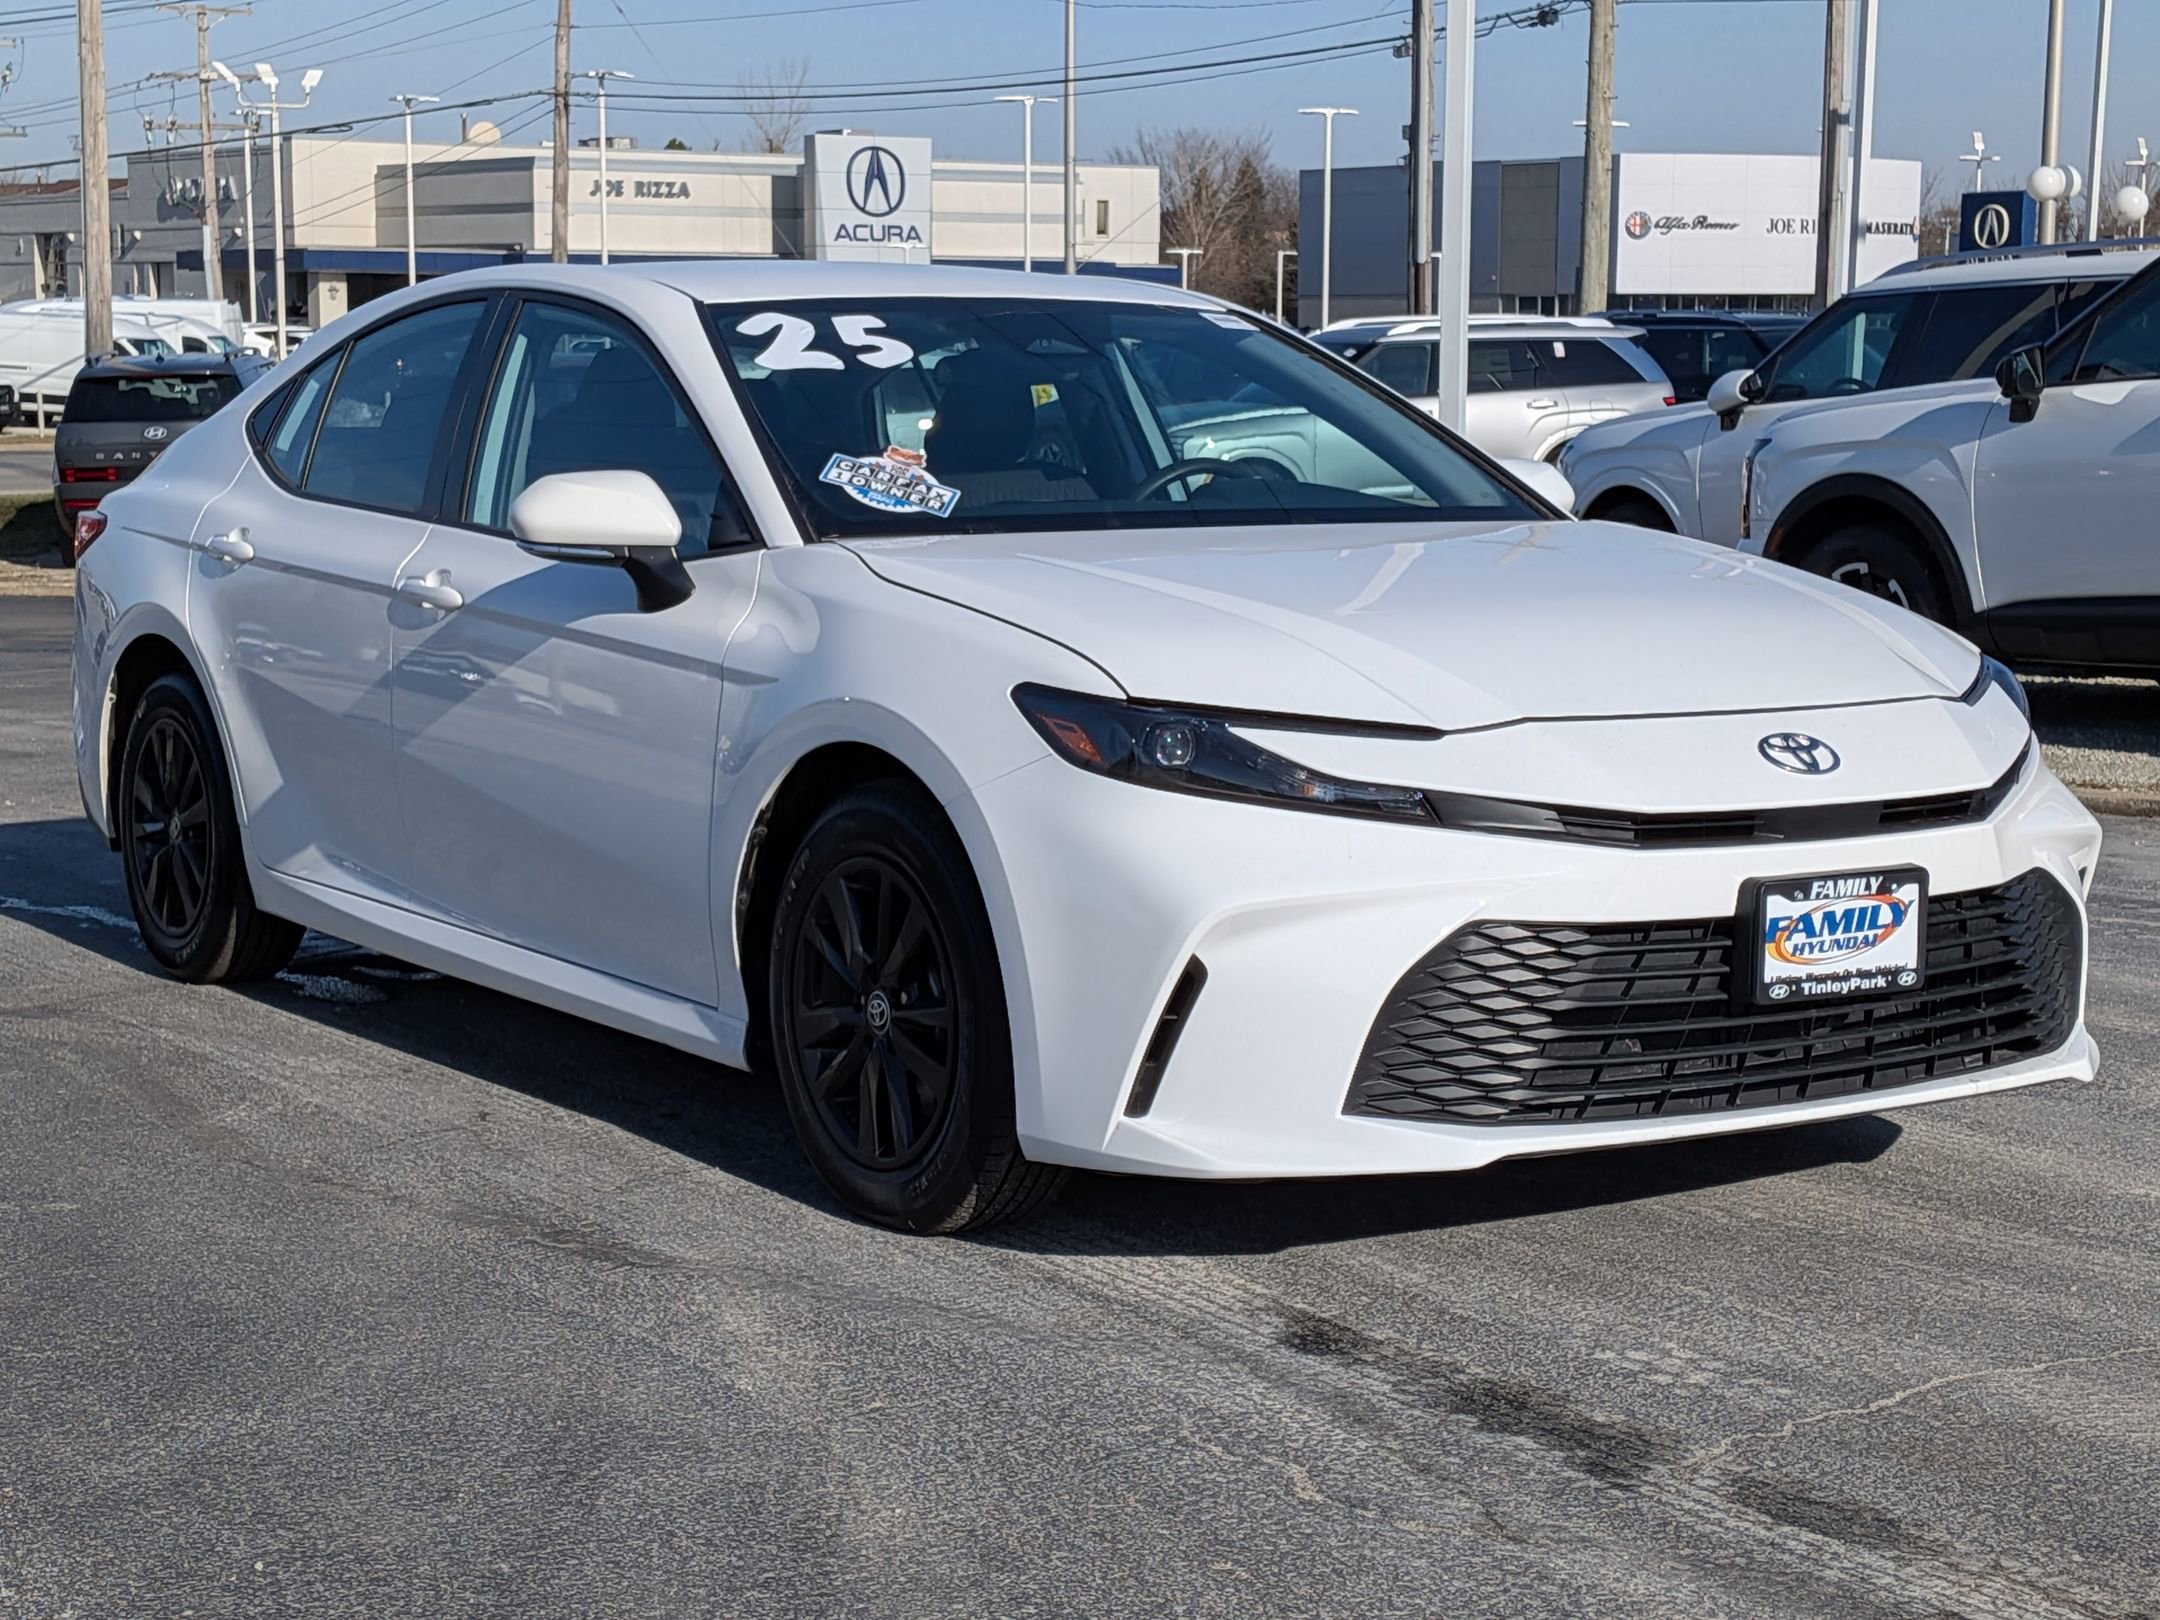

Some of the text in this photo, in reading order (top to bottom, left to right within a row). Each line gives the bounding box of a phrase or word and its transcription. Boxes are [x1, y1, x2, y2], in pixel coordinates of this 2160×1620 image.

[589, 179, 692, 200] JOE RIZZA
[833, 223, 923, 244] ACURA
[1653, 216, 1692, 236] Alfa
[1766, 218, 1797, 235] JOE
[737, 313, 914, 370] 25
[95, 450, 158, 461] SANT
[839, 461, 948, 502] CARFAX
[851, 477, 943, 511] OWNER
[1809, 876, 1884, 900] FAMILY
[1766, 899, 1916, 944] FAMILY
[1791, 933, 1880, 957] HYUNDAI
[1801, 975, 1887, 996] TinleyPark
